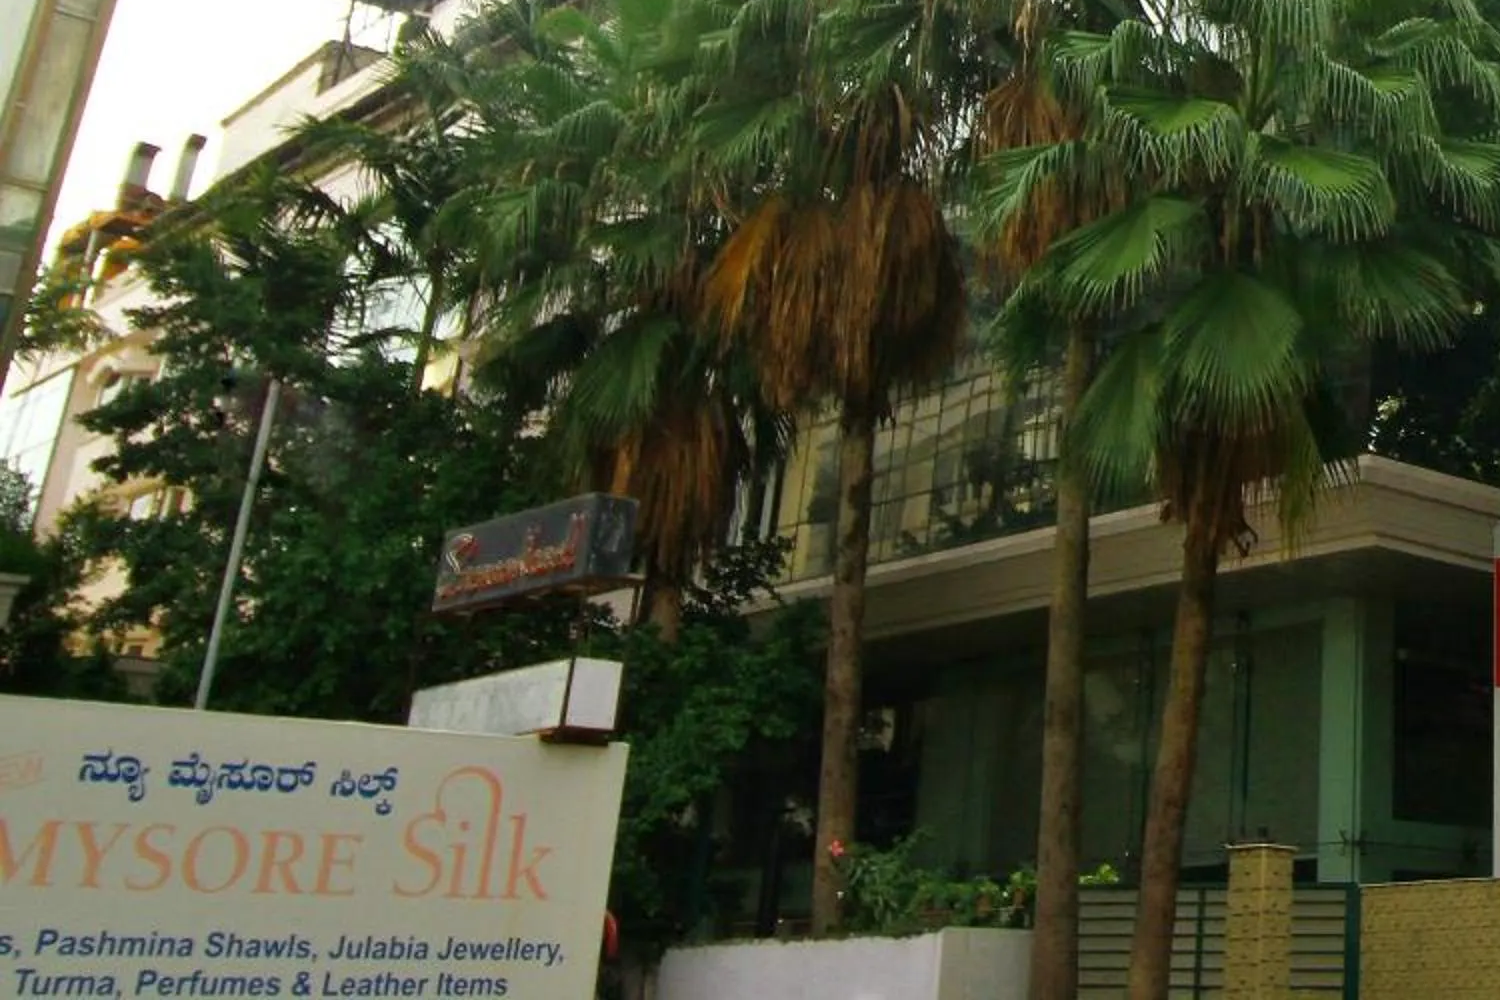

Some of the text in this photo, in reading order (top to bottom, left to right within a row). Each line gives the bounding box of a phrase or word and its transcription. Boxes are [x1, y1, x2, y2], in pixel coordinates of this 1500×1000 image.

[0, 765, 558, 900] MYSORE Silk
[35, 929, 193, 958] Pashmina
[204, 932, 318, 962] Shawls,
[328, 935, 428, 960] Julabia
[437, 936, 564, 966] Jewellery,
[15, 969, 509, 999] Turma, Perfumes & Leather Items
